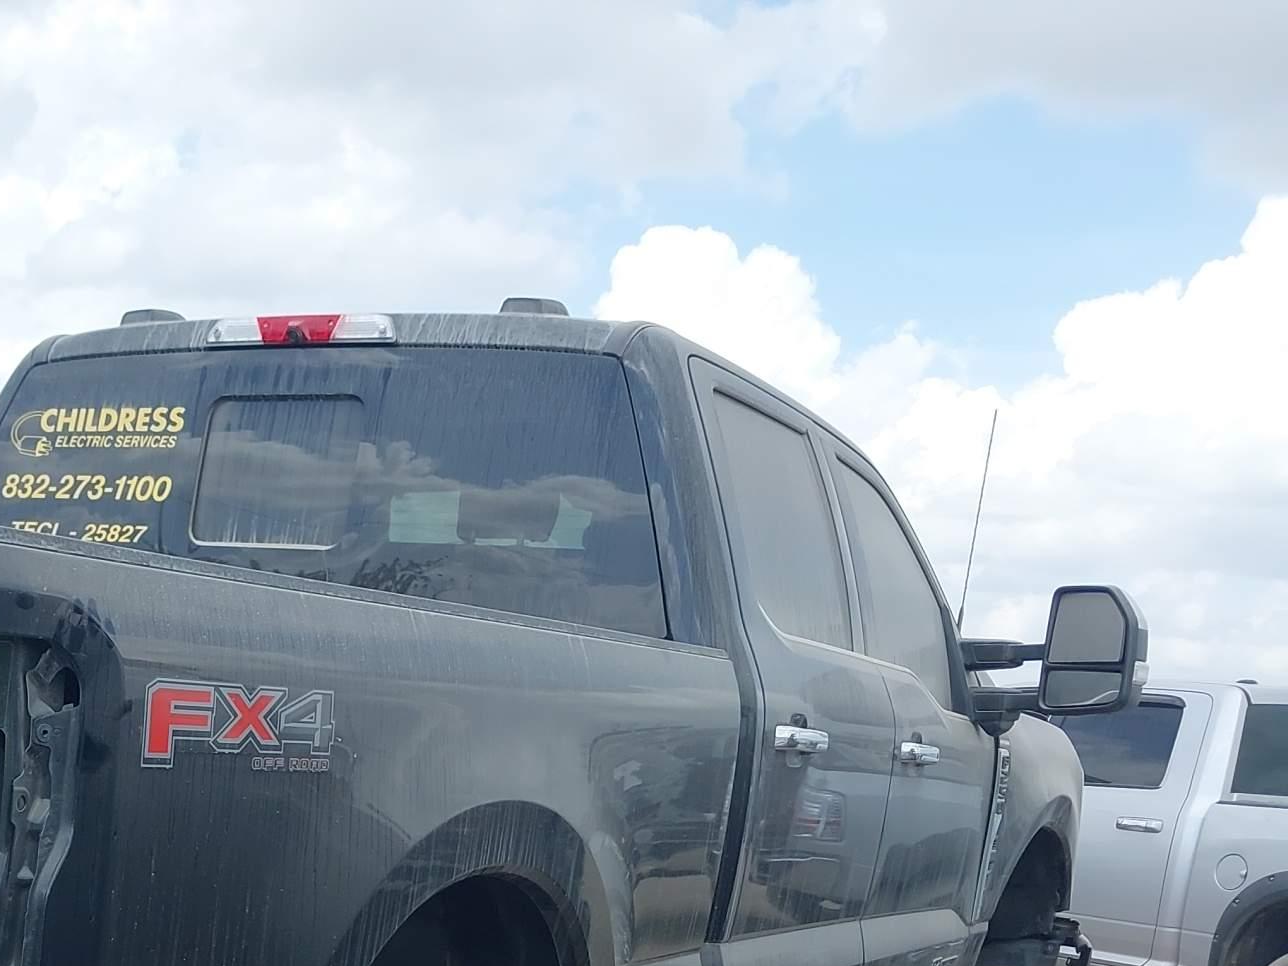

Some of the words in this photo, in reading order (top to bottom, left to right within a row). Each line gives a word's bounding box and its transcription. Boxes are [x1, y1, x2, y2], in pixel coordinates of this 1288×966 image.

[40, 406, 186, 433] CHILDRESS
[54, 435, 114, 448] ELECTRIC
[114, 435, 177, 449] SERVICES
[1, 473, 173, 502] 832-273-1100
[80, 523, 149, 544] 25827
[140, 678, 335, 768] FX4
[252, 757, 285, 771] OFF
[289, 758, 330, 773] ROAD
